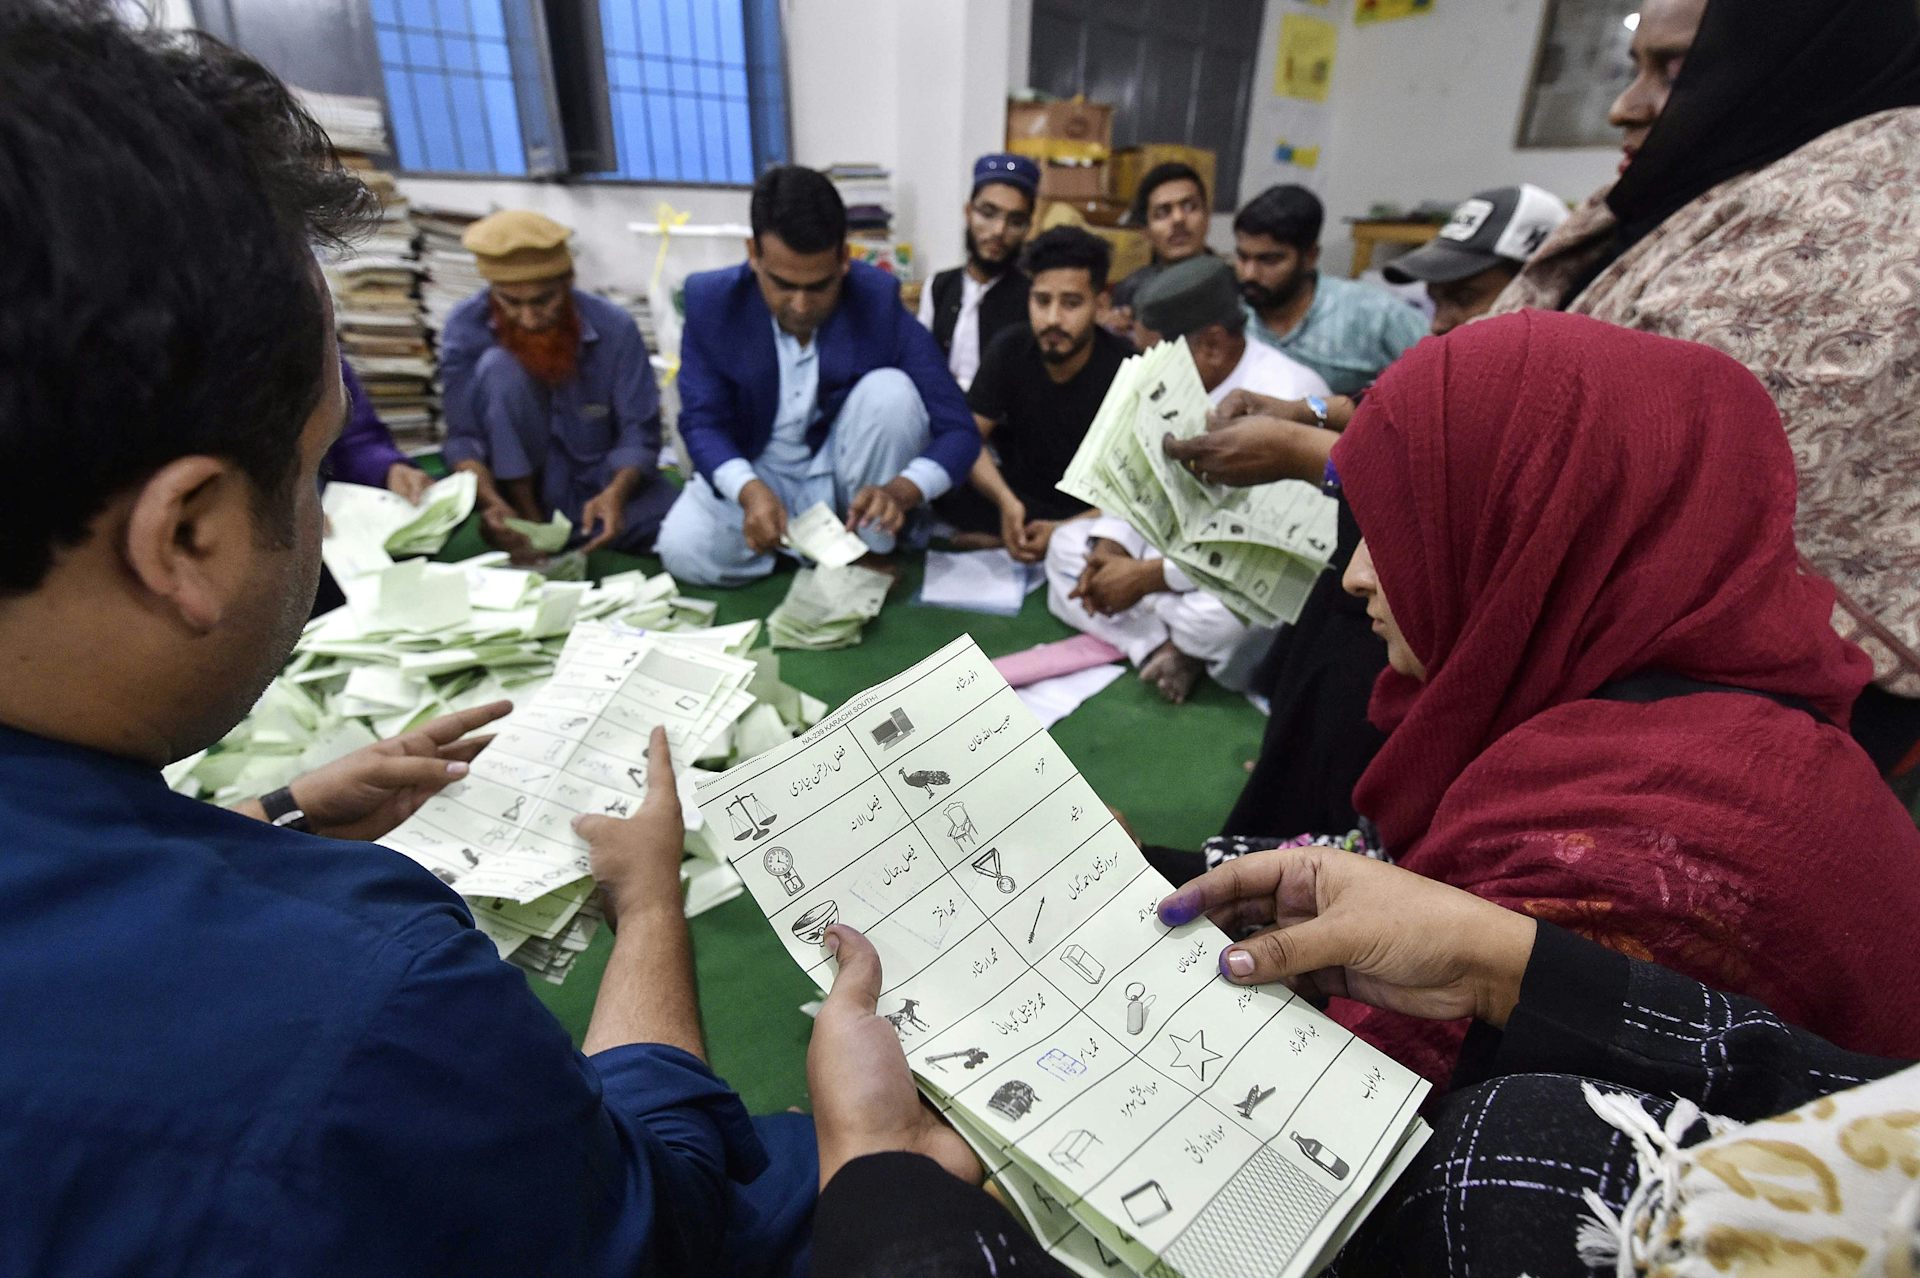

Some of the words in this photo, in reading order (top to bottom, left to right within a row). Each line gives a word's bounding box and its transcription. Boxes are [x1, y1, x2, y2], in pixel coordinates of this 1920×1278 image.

[966, 668, 979, 686] انور
[801, 728, 825, 746] NA-239
[824, 709, 854, 731] KARACHI
[991, 713, 1011, 734] حبیب
[966, 733, 983, 752] خان
[831, 743, 846, 772] فضل
[788, 776, 813, 798] نیازی
[864, 793, 883, 822] فیصل
[1070, 804, 1084, 822] رشید
[900, 843, 918, 873] فیصل
[1103, 850, 1118, 872] سردار
[881, 865, 903, 886] جمال
[1082, 872, 1094, 889] احمد
[931, 904, 949, 927] اختر
[948, 897, 956, 917] محمد
[1137, 907, 1148, 923] احمد
[989, 946, 999, 965] محمد
[1188, 939, 1208, 964] سلیمان
[971, 956, 992, 978] ارشاد
[1177, 955, 1190, 974] خان
[1036, 991, 1046, 1010] محمد
[1088, 1036, 1100, 1053] محمد
